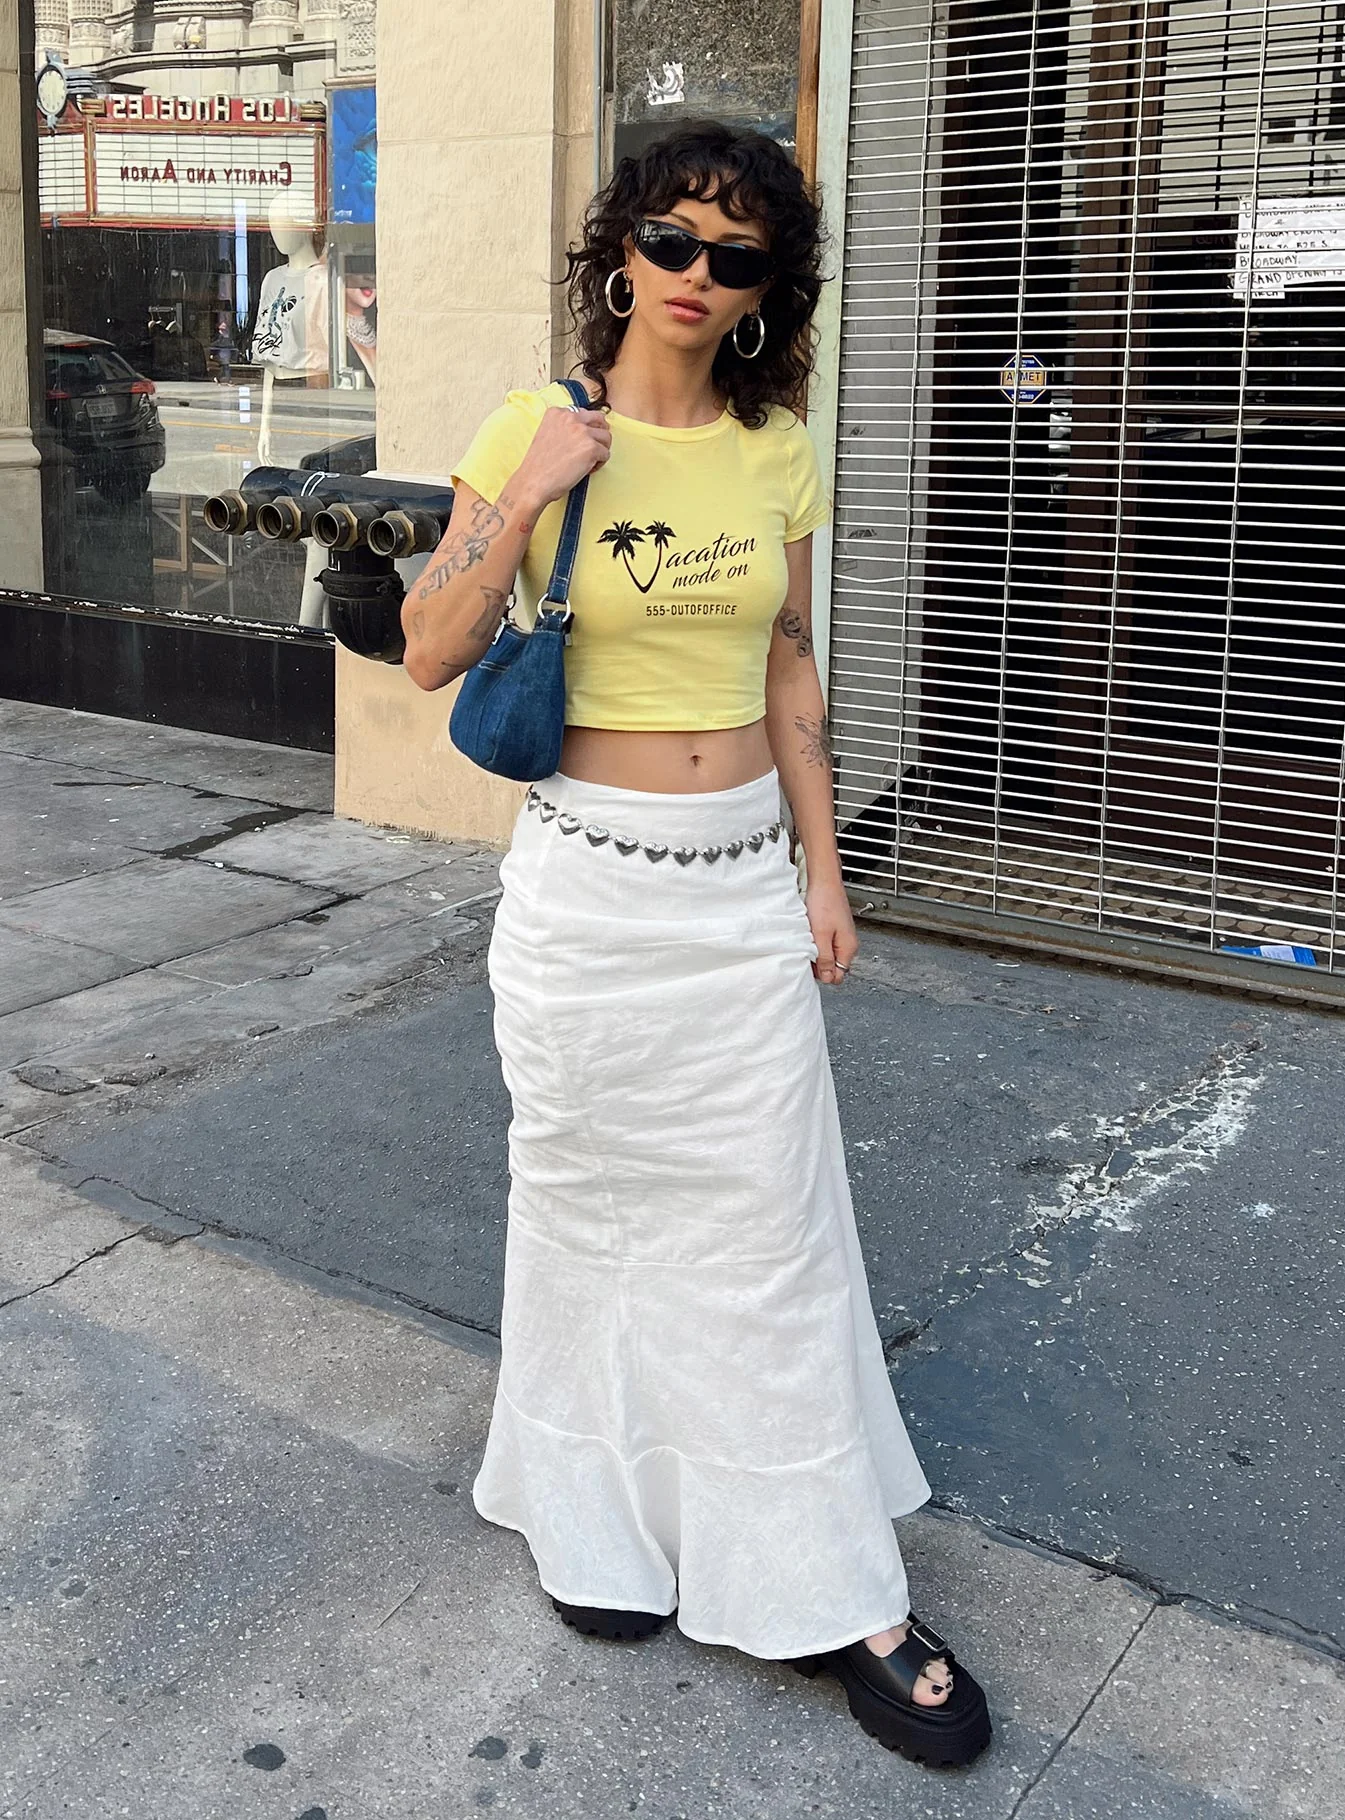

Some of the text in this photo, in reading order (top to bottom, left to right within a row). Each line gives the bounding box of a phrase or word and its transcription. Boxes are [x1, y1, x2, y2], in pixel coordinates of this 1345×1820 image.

[672, 561, 751, 589] mode on
[646, 604, 738, 616] 555-OUTOFOFFICE
